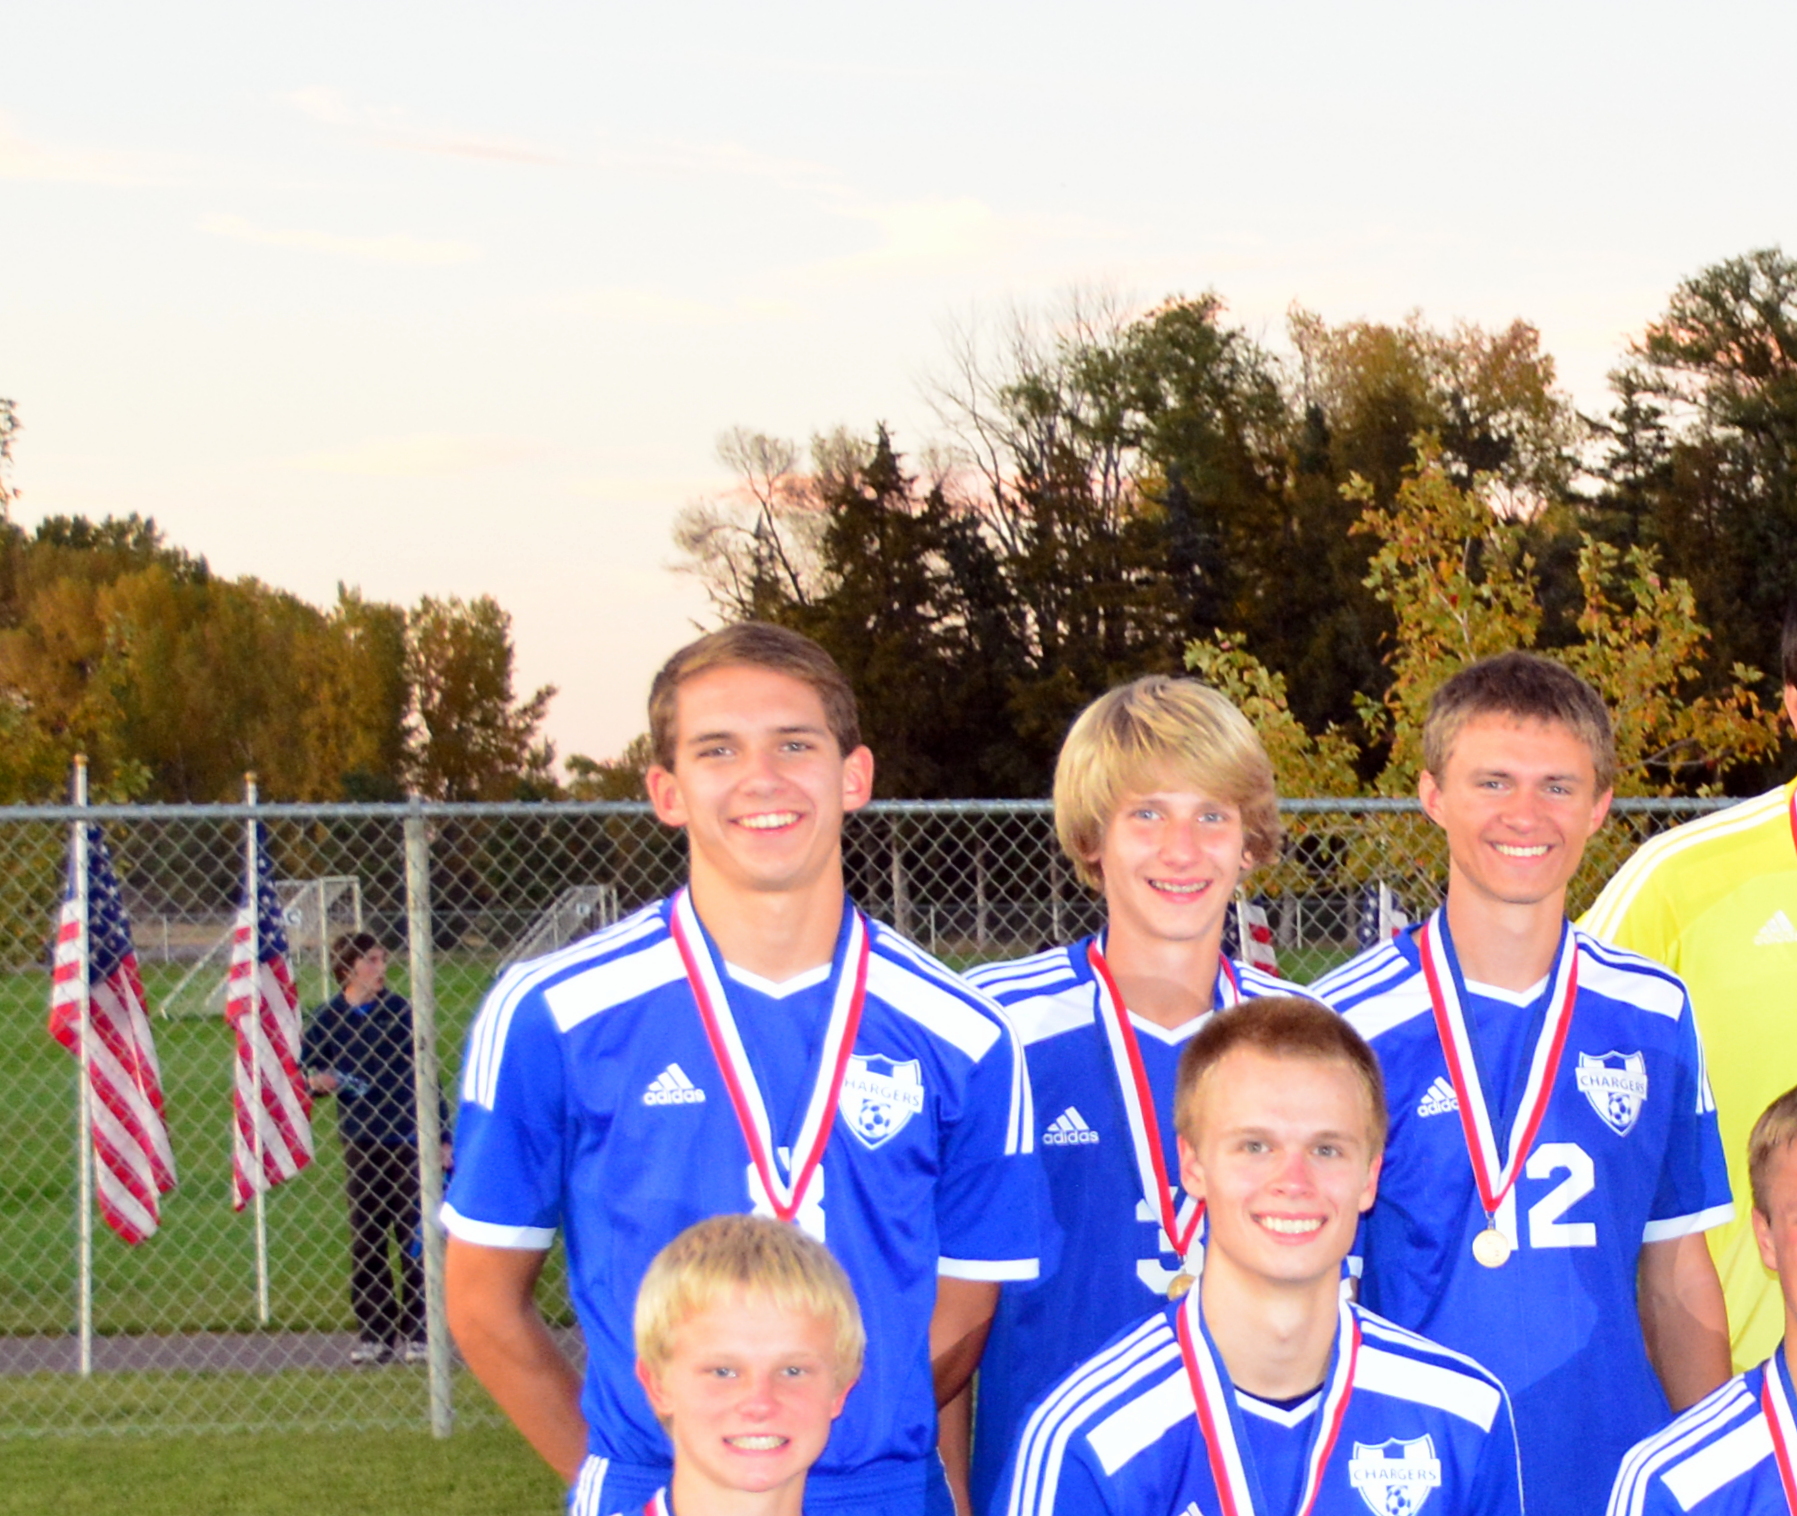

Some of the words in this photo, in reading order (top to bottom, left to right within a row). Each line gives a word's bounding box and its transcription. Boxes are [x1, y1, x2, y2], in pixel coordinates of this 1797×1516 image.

[844, 1076, 921, 1107] HARGERS
[1580, 1074, 1645, 1095] CHARGERS
[643, 1088, 706, 1106] adidas
[1042, 1128, 1099, 1146] adidas
[1353, 1467, 1438, 1483] CHARGERS
